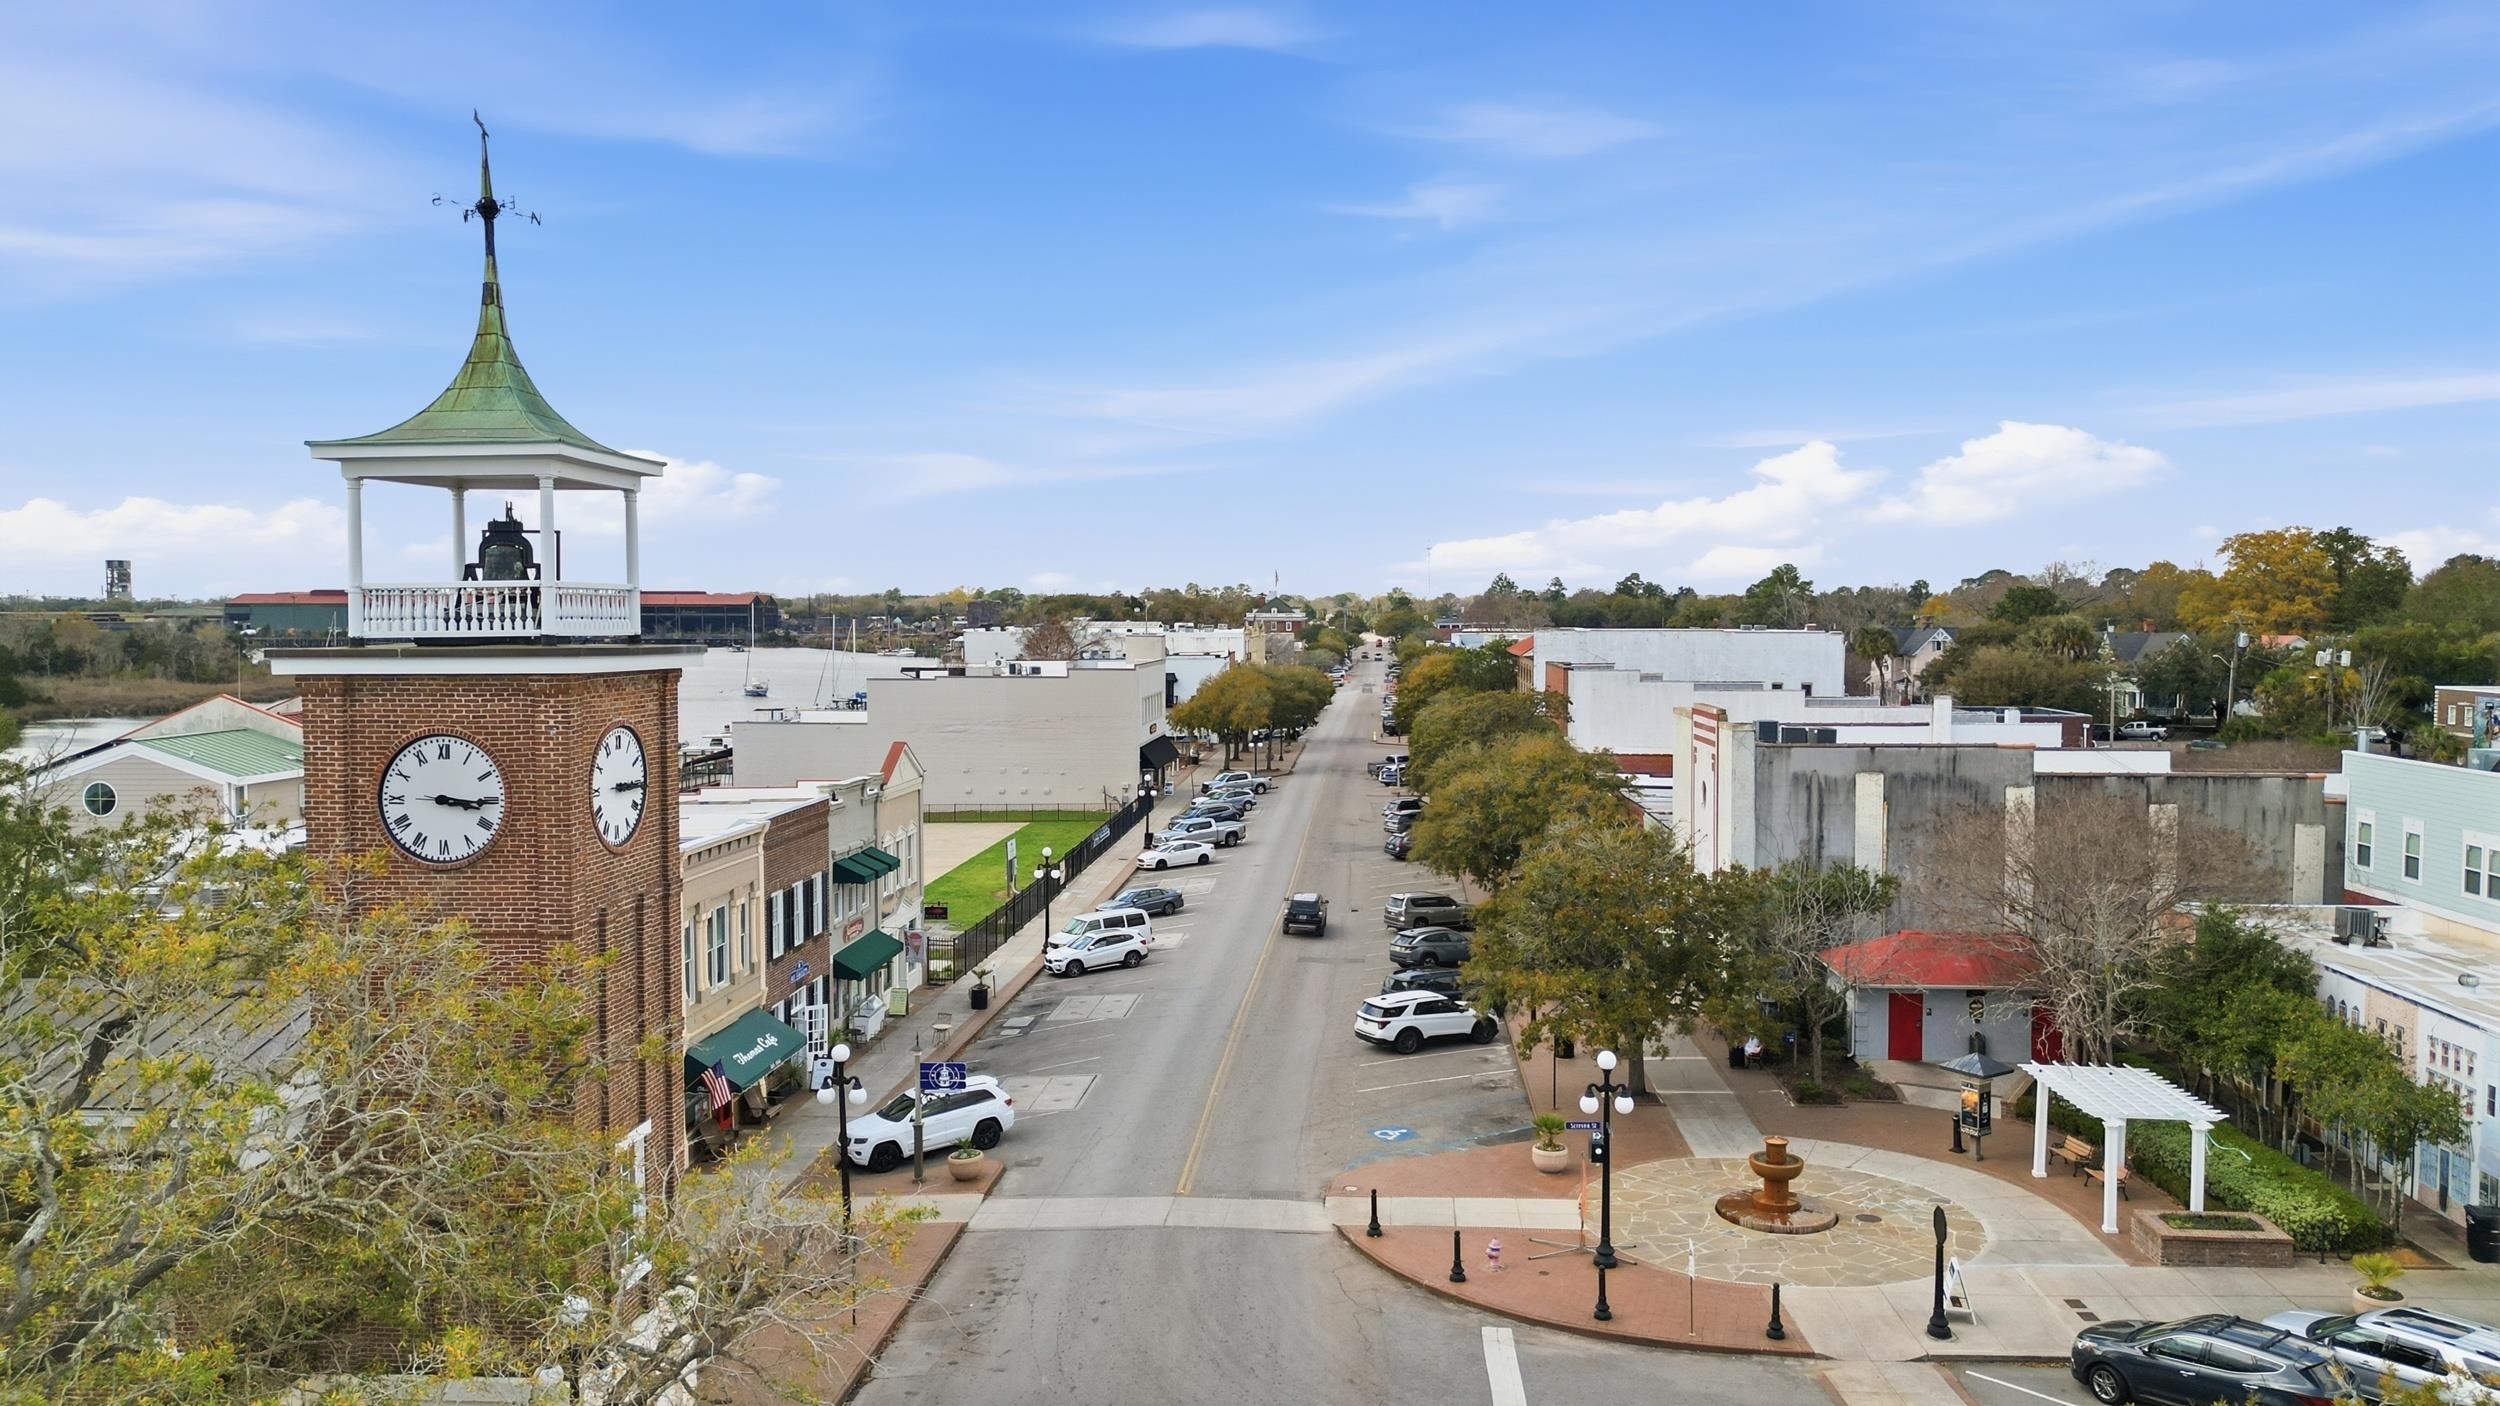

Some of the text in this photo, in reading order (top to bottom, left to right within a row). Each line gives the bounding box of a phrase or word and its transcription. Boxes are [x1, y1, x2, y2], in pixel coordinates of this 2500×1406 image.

[530, 211, 541, 226] N
[413, 749, 428, 767] XI
[438, 744, 450, 760] XII
[463, 751, 472, 766] I
[395, 769, 411, 782] X
[477, 770, 492, 782] II
[596, 763, 603, 775] X
[388, 795, 405, 805] IX
[393, 813, 412, 834] VIII
[476, 816, 494, 832] IIII
[412, 832, 428, 850] VII
[439, 840, 450, 856] VI
[464, 834, 475, 850] V
[732, 1044, 765, 1065] Thomas
